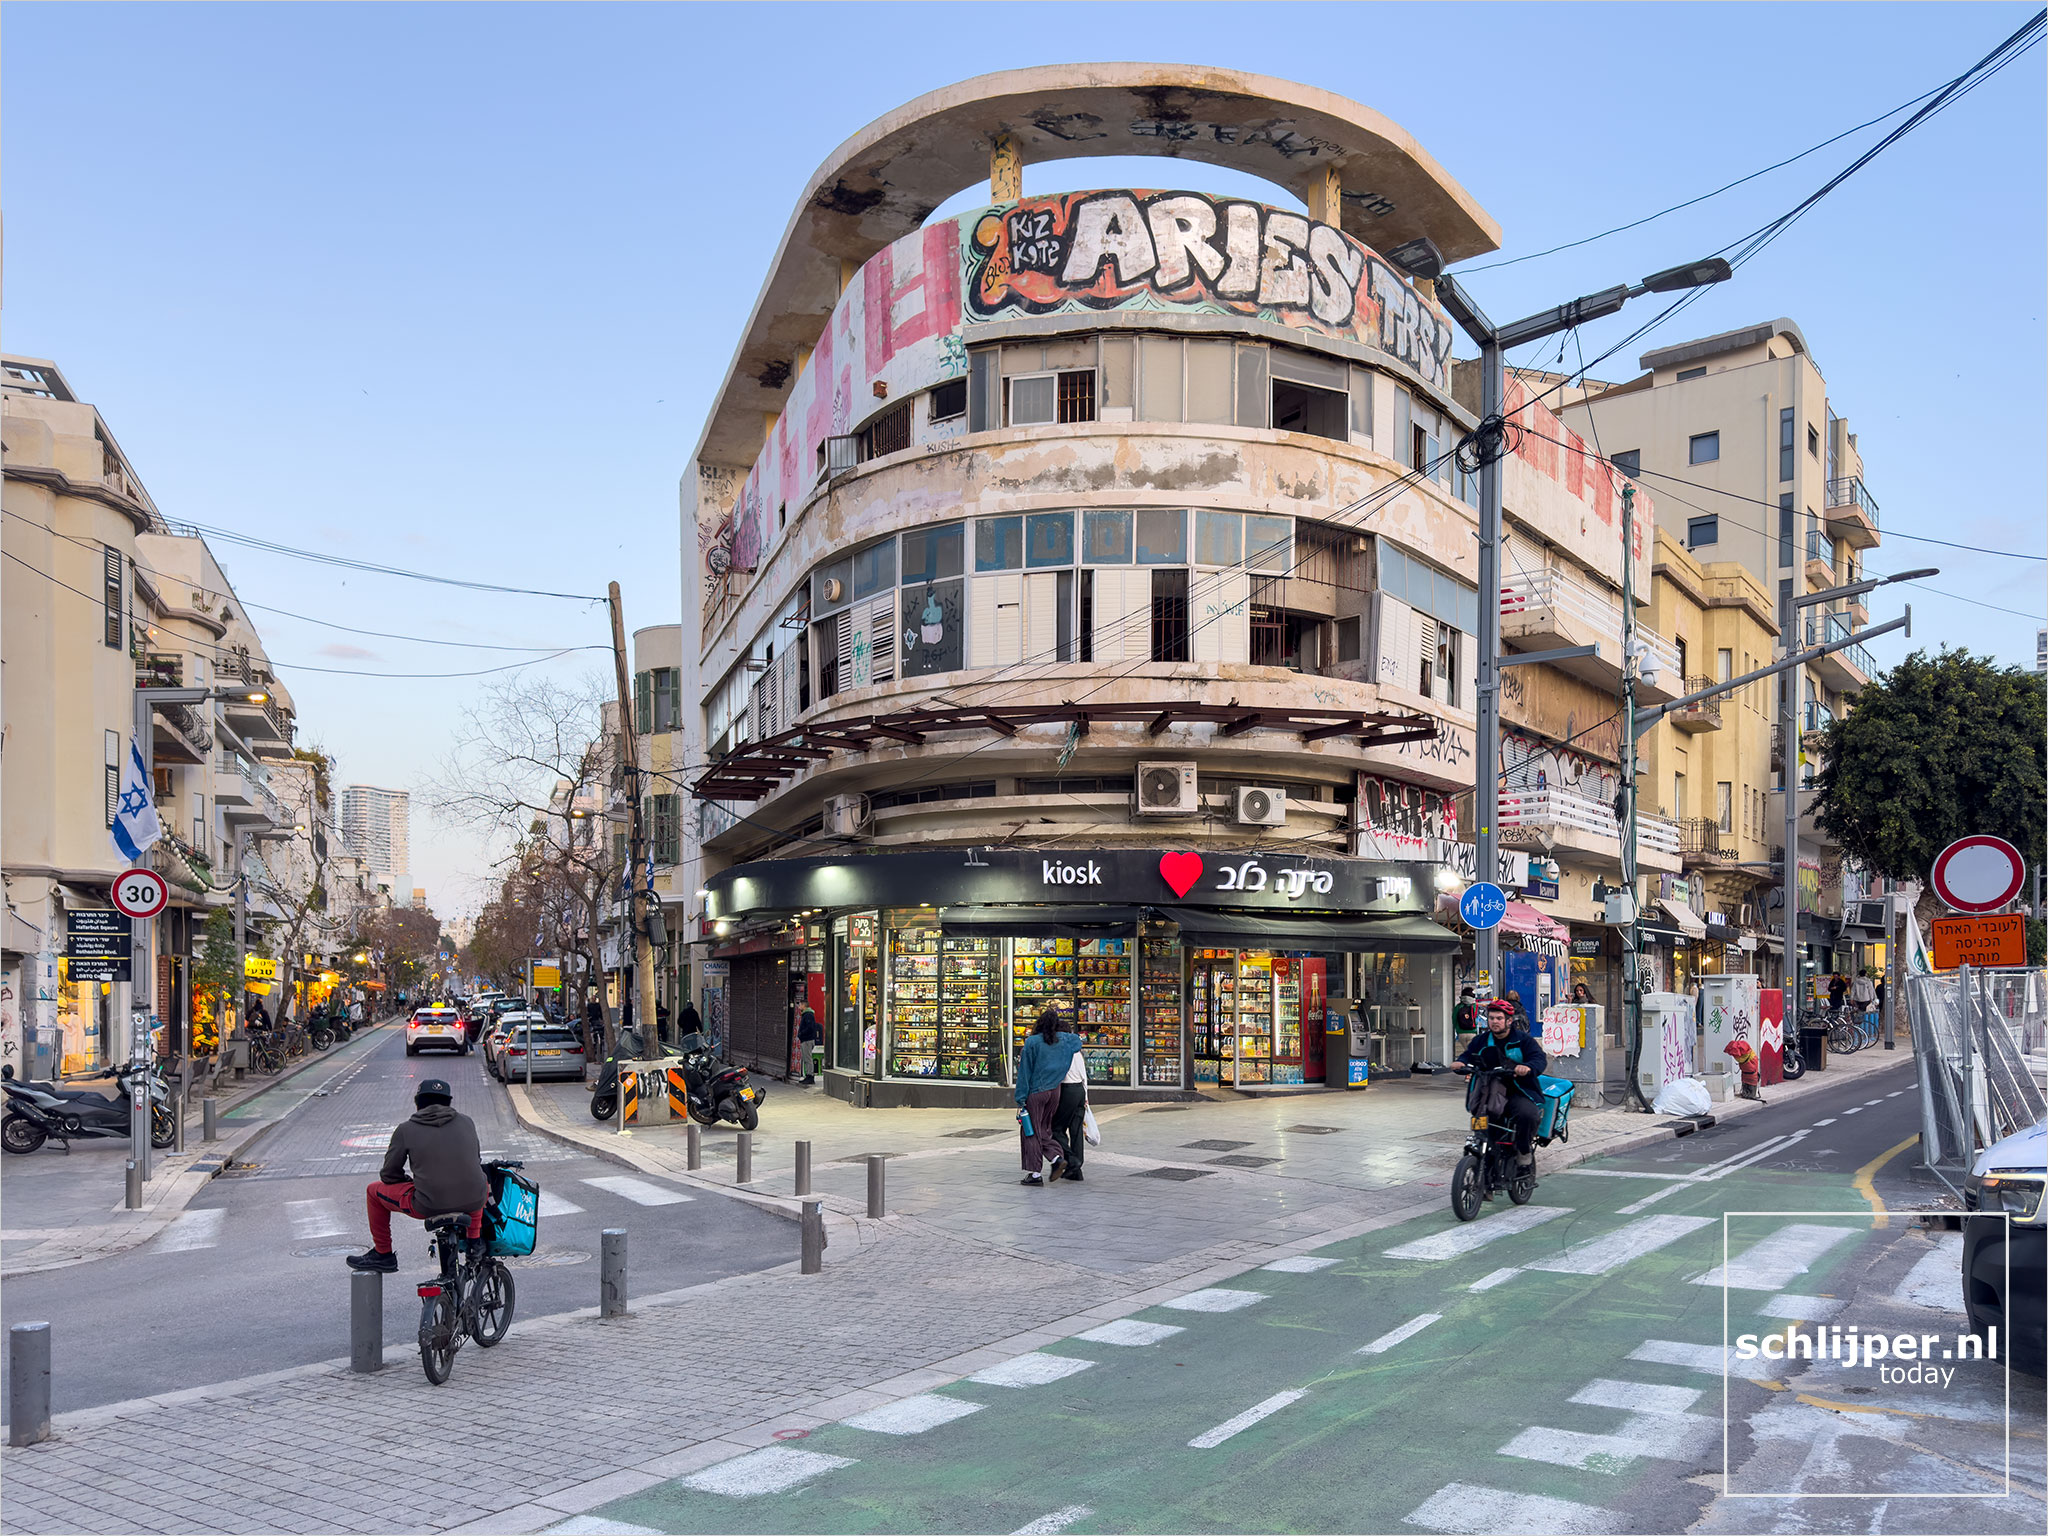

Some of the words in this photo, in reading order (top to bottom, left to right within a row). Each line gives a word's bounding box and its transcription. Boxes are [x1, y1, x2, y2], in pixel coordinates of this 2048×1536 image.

[1061, 193, 1364, 325] ARIES
[1042, 860, 1102, 885] kiosk
[1215, 861, 1267, 891] בלב
[1274, 869, 1333, 899] פינה
[126, 885, 154, 903] 30
[1937, 924, 1971, 935] האתר
[1977, 919, 2018, 935] לעובדי
[1955, 937, 2000, 949] הכניסה
[704, 962, 729, 970] CHANGE
[1959, 952, 2000, 963] מותרת
